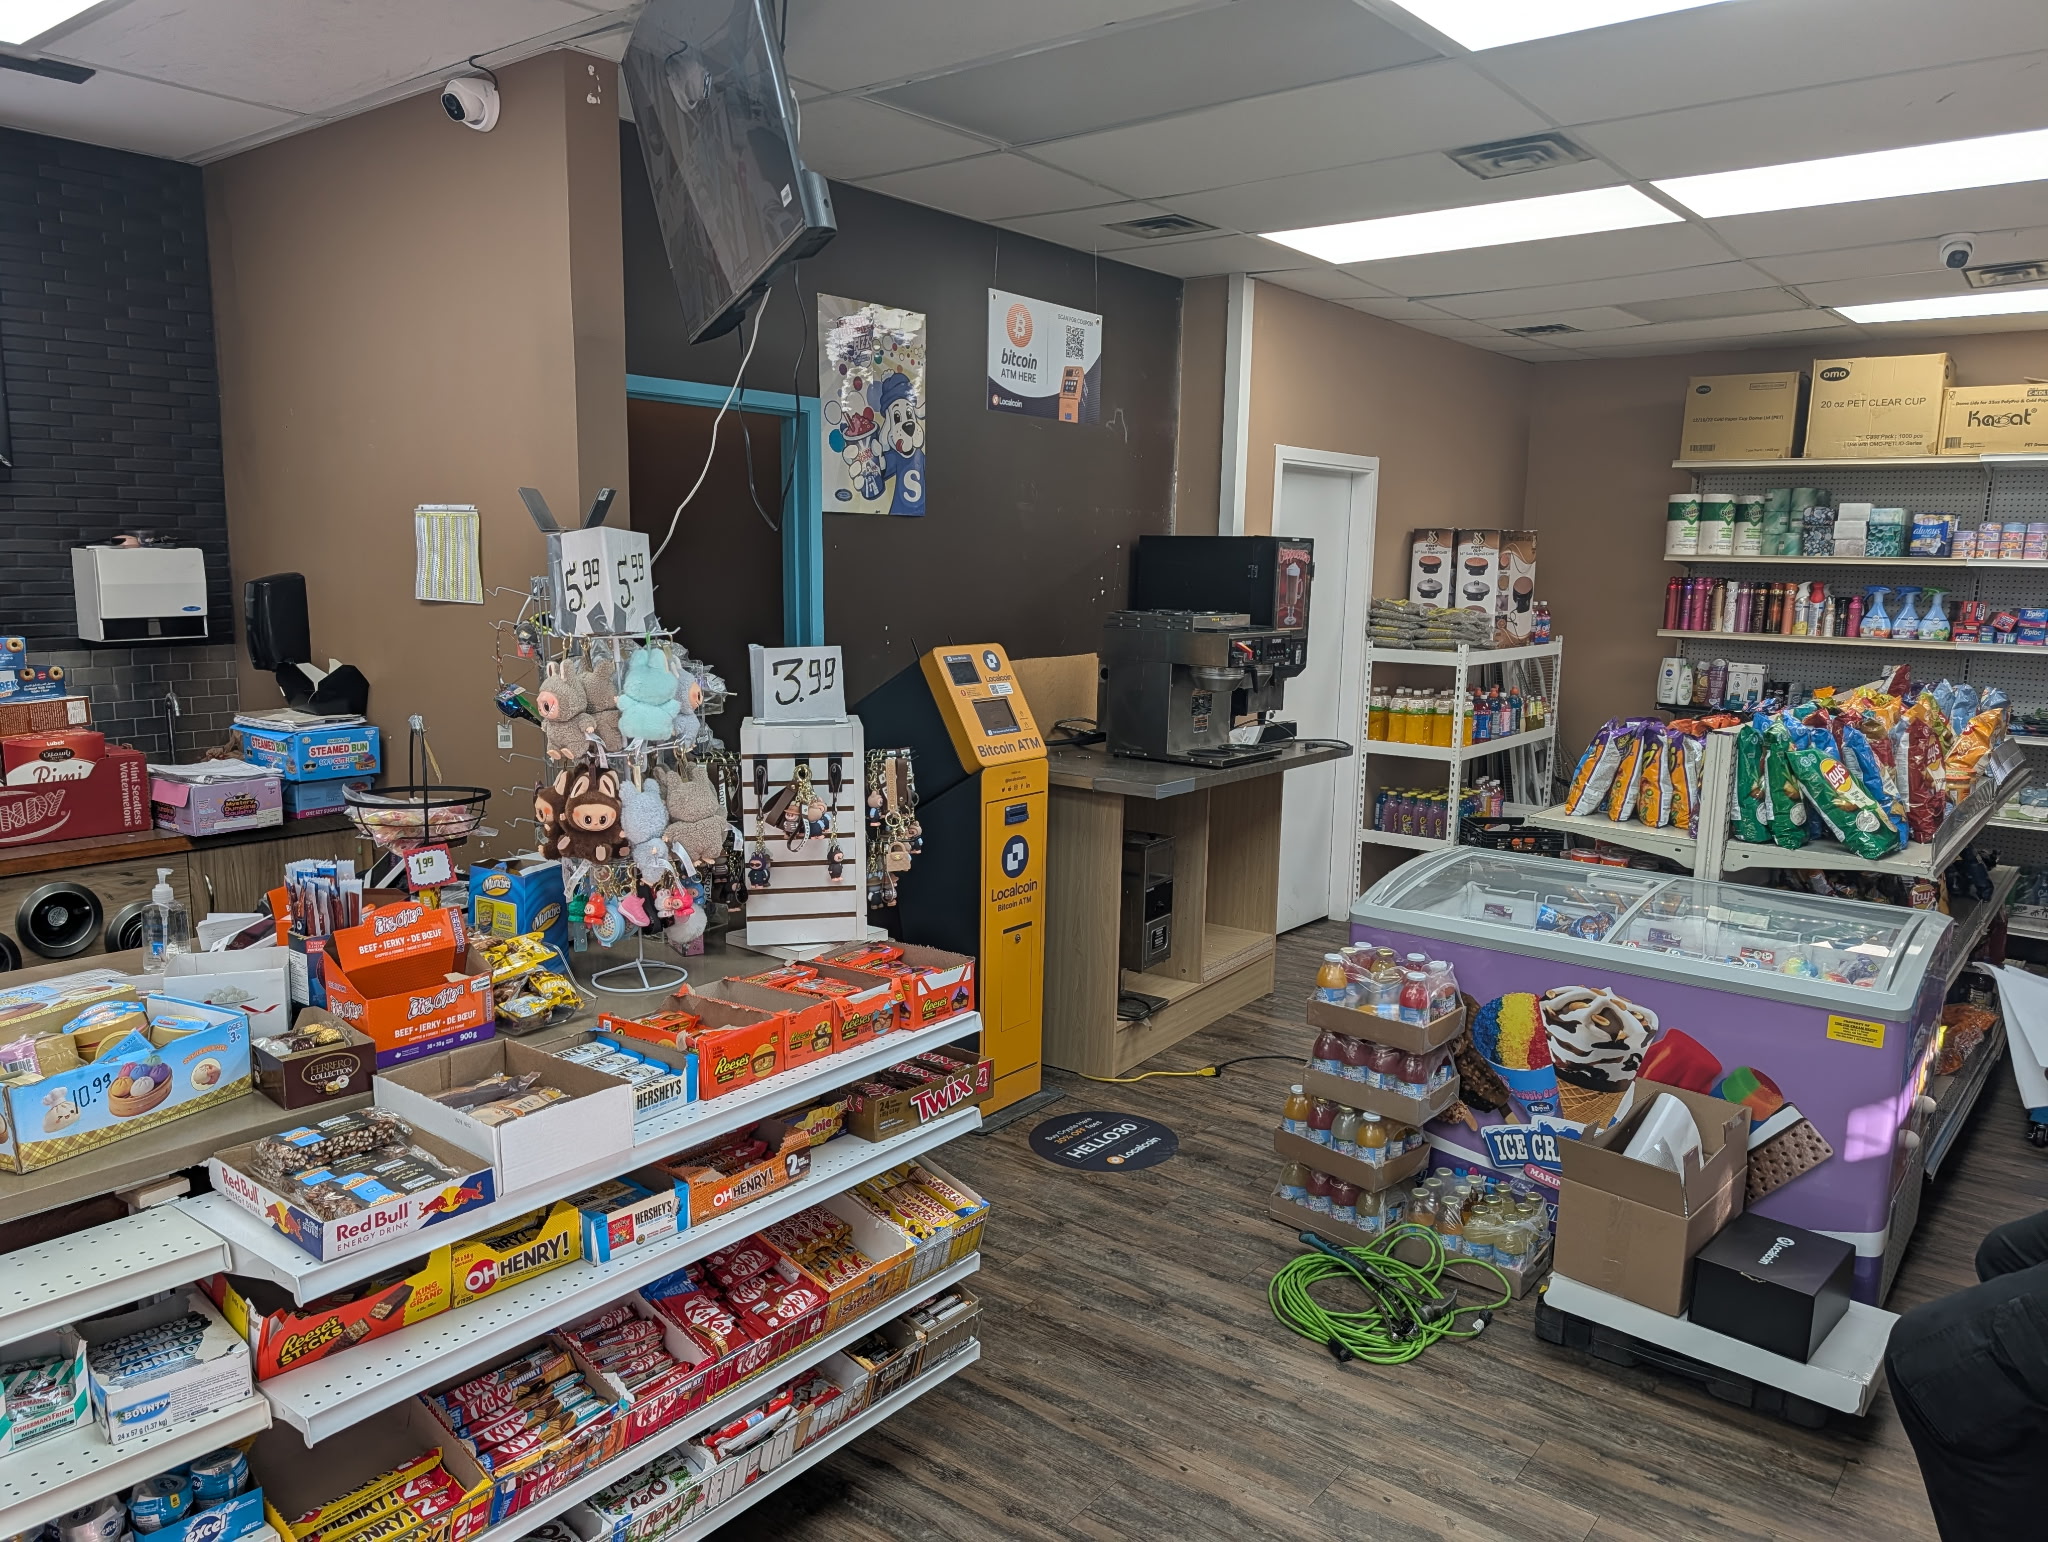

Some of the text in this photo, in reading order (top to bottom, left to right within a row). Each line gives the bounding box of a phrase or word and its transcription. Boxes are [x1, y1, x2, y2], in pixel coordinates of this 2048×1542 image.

[1001, 347, 1037, 370] bitcoin
[1000, 368, 1037, 384] ATM HERE
[1823, 370, 1847, 378] omo
[999, 396, 1023, 409] Localcoin
[1820, 400, 1832, 408] 20
[1847, 399, 1867, 408] PET
[1869, 398, 1902, 407] CLEAR
[1904, 397, 1926, 405] CUP
[903, 469, 922, 502] S
[1913, 525, 1942, 536] always
[565, 557, 601, 613] 5.99
[616, 551, 645, 609] 5.99
[2025, 608, 2046, 618] Ziploc
[2022, 628, 2042, 637] Ziploc
[772, 657, 837, 706] 3.99
[984, 673, 1014, 683] Localcoin
[251, 736, 276, 752] STEAMED
[309, 742, 368, 757] STEAMED BUN
[977, 736, 1042, 758] Bitcoin ATM
[1826, 761, 1847, 788] Lay's
[119, 762, 132, 827] Watermelons
[129, 761, 142, 825] Mini Seedless
[483, 878, 512, 890] Munchies
[991, 877, 1038, 903] Localcoin
[997, 894, 1032, 912] Bitcoin ATM
[532, 905, 562, 931] Munchies
[359, 928, 443, 955] BEEF JERKY DE BŒUF
[922, 996, 949, 1013] Reese's
[394, 1009, 477, 1039] BEEF JERKY DE BŒUF
[459, 1032, 472, 1042] 900
[310, 1054, 353, 1074] FERRERO
[310, 1065, 353, 1082] COLLECTION
[714, 1052, 751, 1077] Reese's
[975, 1066, 989, 1087] 4
[636, 1079, 682, 1110] HERSHEY'S
[879, 1100, 890, 1111] 24
[1066, 1122, 1138, 1159] HELLO30
[1117, 1136, 1162, 1159] Localcoin
[1493, 1133, 1529, 1161] ICE
[221, 1167, 260, 1205] Red Bull
[712, 1154, 799, 1208] OH HENRY! 2
[336, 1210, 374, 1242] Red
[373, 1202, 410, 1231] Bull
[635, 1200, 672, 1226] HERSHEY'S
[337, 1220, 409, 1252] ENERGY DRINK
[465, 1231, 571, 1290] OH HENRY!
[409, 1287, 443, 1309] GRAND
[414, 1282, 438, 1299] KING
[684, 1299, 734, 1336] KitKat
[282, 1315, 340, 1357] Reese's
[470, 1367, 541, 1420] KitKat CHUNKY
[13, 1406, 74, 1435] FISHERMAN'S FRIEND
[124, 1398, 171, 1421] BOUNTY
[21, 1416, 68, 1439] MINT MENTHE
[117, 1432, 126, 1441] 24
[131, 1430, 139, 1438] 57
[158, 1418, 168, 1431] kg)
[402, 1479, 421, 1500] 2
[630, 1478, 668, 1510] Aero
[413, 1496, 439, 1519] 2
[185, 1513, 227, 1542] excel
[454, 1512, 474, 1541] 2
